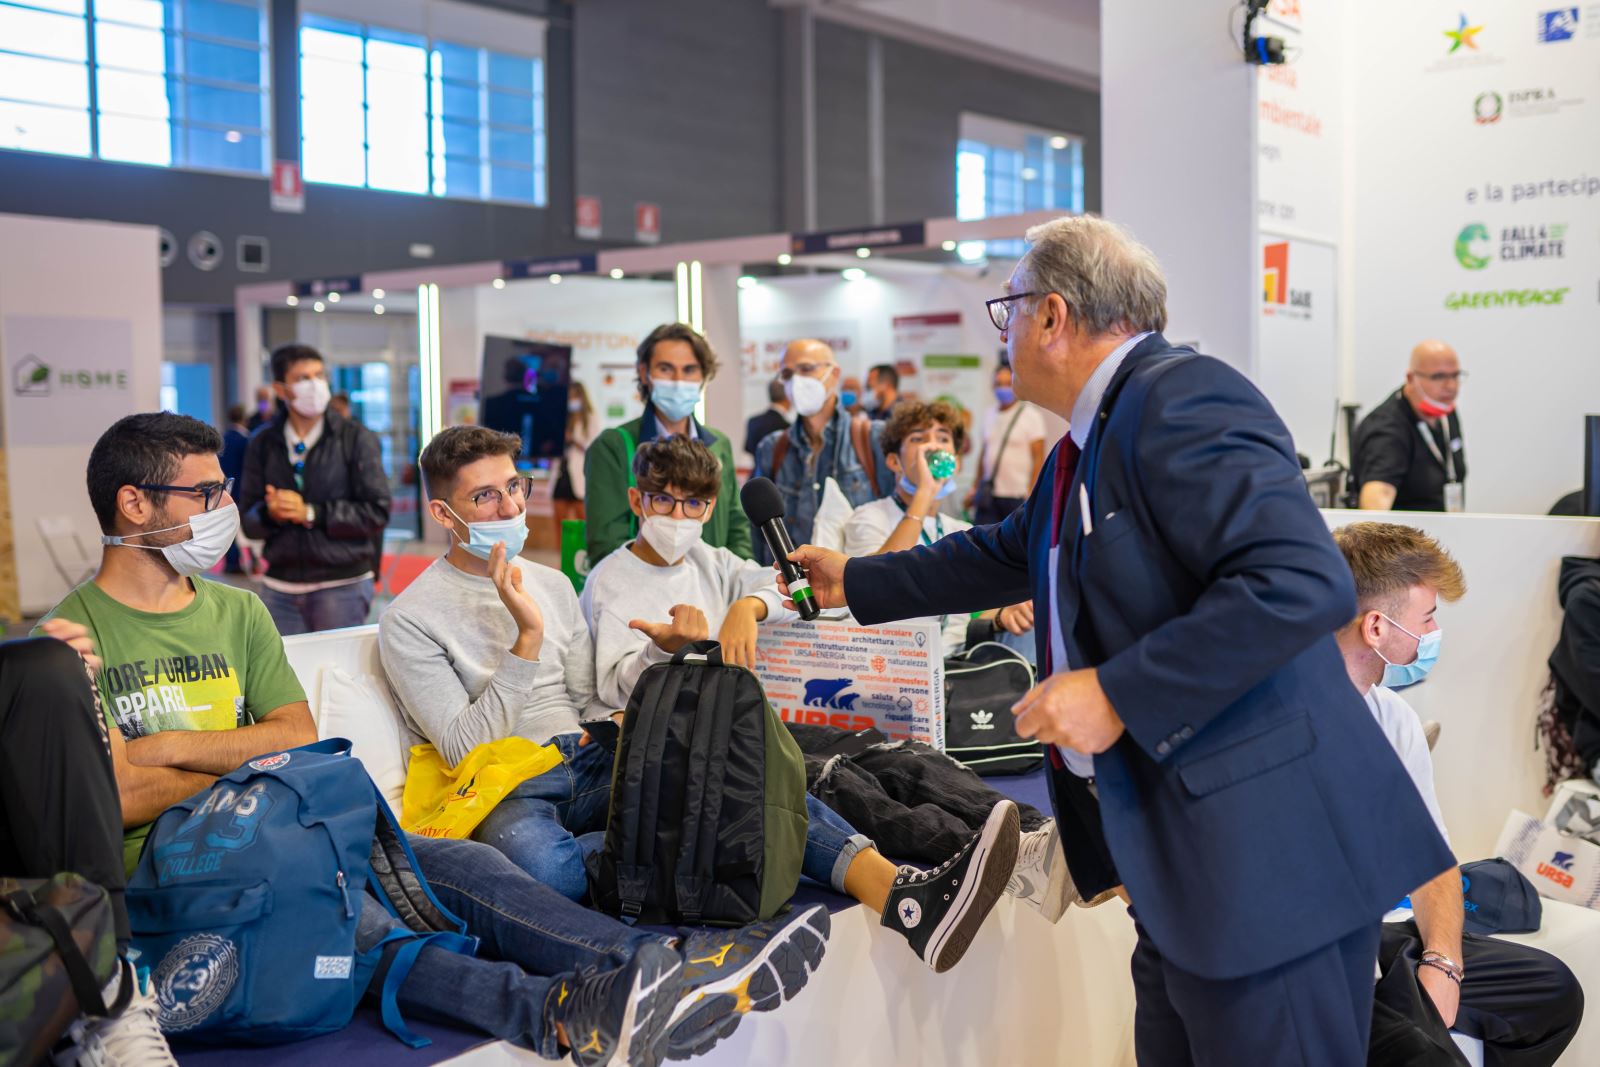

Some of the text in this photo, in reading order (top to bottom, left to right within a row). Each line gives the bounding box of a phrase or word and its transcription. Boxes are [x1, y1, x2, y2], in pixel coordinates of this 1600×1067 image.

[1466, 188, 1478, 202] e
[1486, 183, 1503, 201] la
[1445, 287, 1569, 309] GREENPEACE
[792, 621, 815, 630] edilizia
[883, 629, 912, 637] circolare
[851, 636, 895, 646] architettura
[812, 643, 868, 654] ristrutturazione
[898, 649, 928, 659] riciclato
[840, 661, 869, 672] progetto
[887, 657, 928, 668] naturalezza
[760, 673, 802, 683] ristrutturare
[899, 686, 929, 696] persone
[892, 676, 929, 686] atmosfera
[871, 692, 893, 701] salute
[884, 712, 929, 724] riqualificare
[160, 848, 227, 883] COLLEGE
[173, 968, 209, 991] 23
